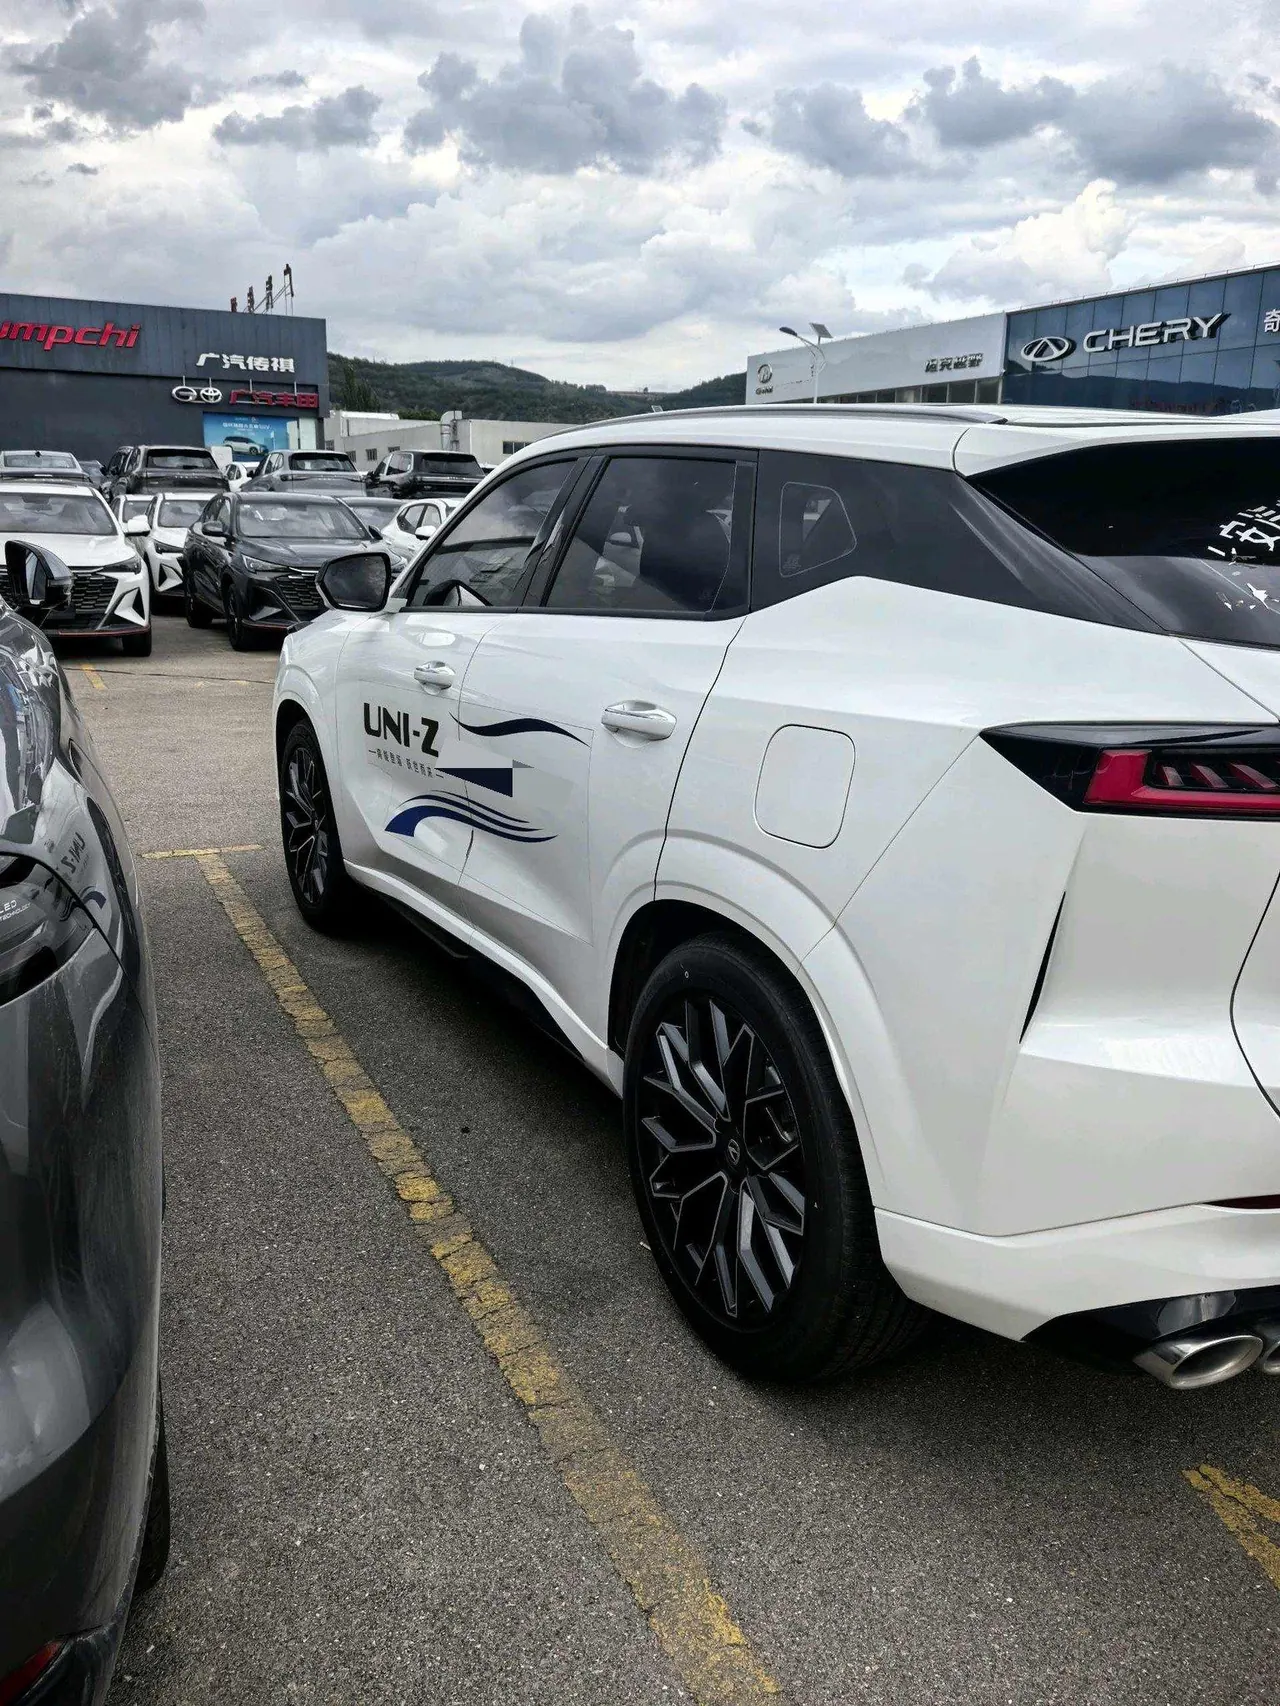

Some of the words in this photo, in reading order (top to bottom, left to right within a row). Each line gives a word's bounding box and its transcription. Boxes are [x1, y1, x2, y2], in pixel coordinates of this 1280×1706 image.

[1082, 312, 1224, 353] CHERY
[196, 352, 295, 373] 广汽传祺
[229, 389, 319, 408] 广汽丰田
[363, 702, 439, 758] UNI-Z
